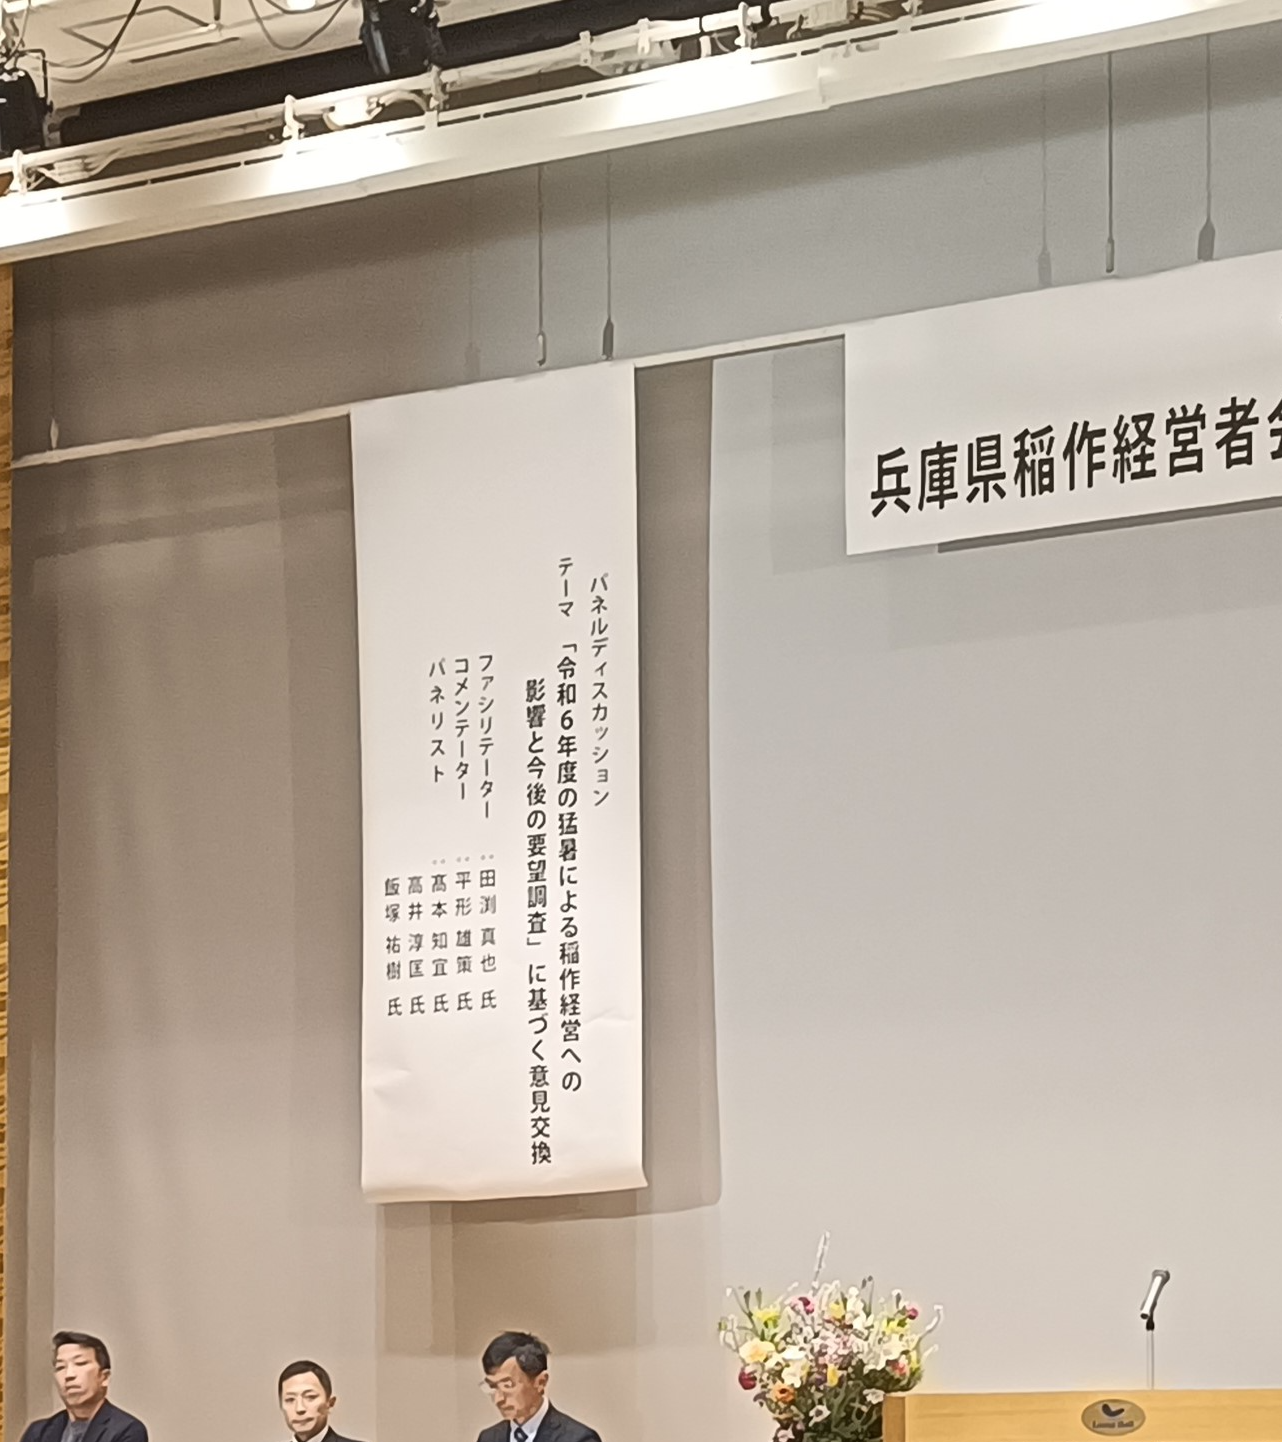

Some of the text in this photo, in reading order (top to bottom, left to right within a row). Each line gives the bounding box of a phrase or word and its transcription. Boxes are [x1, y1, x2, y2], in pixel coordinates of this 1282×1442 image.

[428, 656, 446, 784] パネリスト
[454, 657, 469, 801] コメンテーター
[478, 654, 494, 819] ファシリテーター
[590, 572, 609, 807] パネルディスカッション
